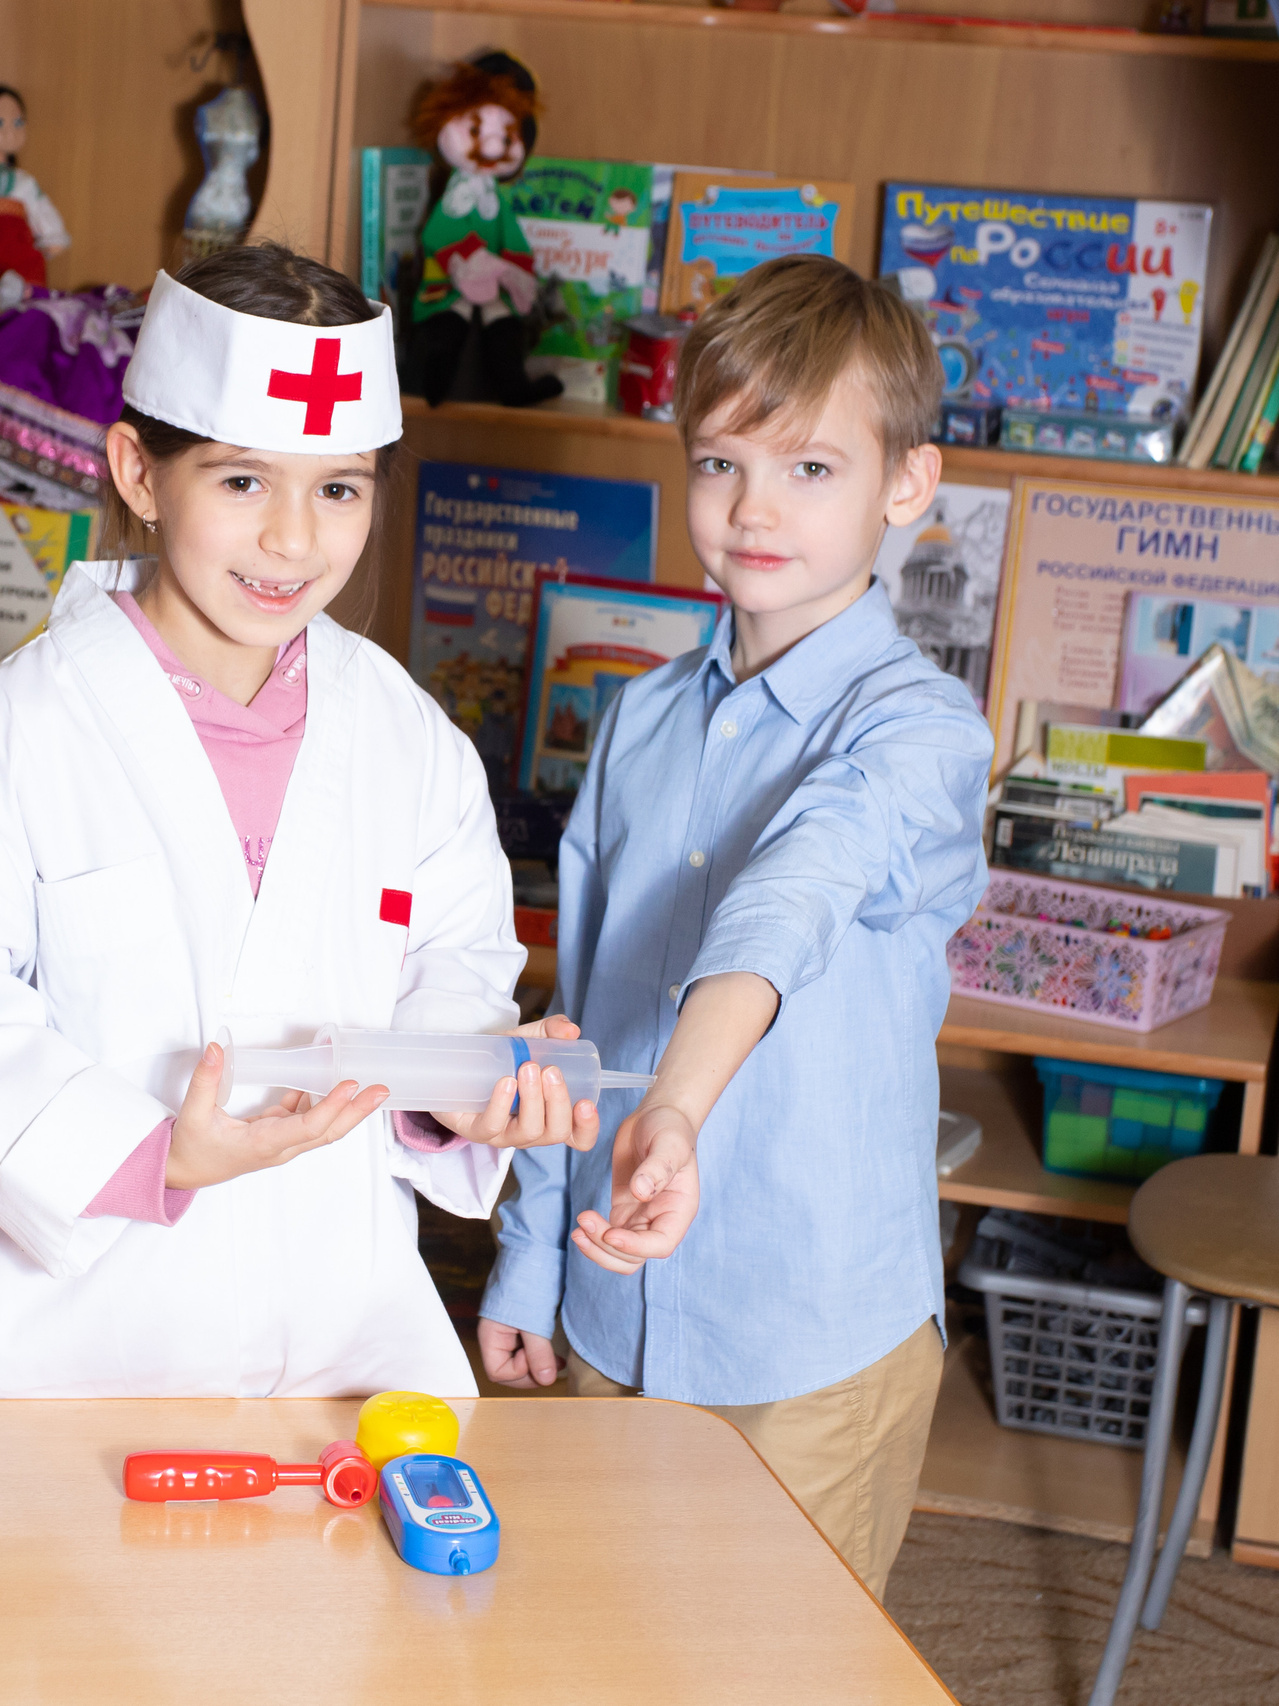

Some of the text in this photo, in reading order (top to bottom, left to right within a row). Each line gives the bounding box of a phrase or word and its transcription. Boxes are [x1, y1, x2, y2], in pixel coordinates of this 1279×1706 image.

[896, 190, 1130, 234] Путешествие
[976, 221, 1173, 277] России
[424, 490, 579, 531] Государственные
[424, 524, 518, 550] праздники
[1116, 526, 1220, 562] ГИМН
[1037, 559, 1167, 587] РОССИЙСКОЙ
[1051, 840, 1179, 876] Ленинграда
